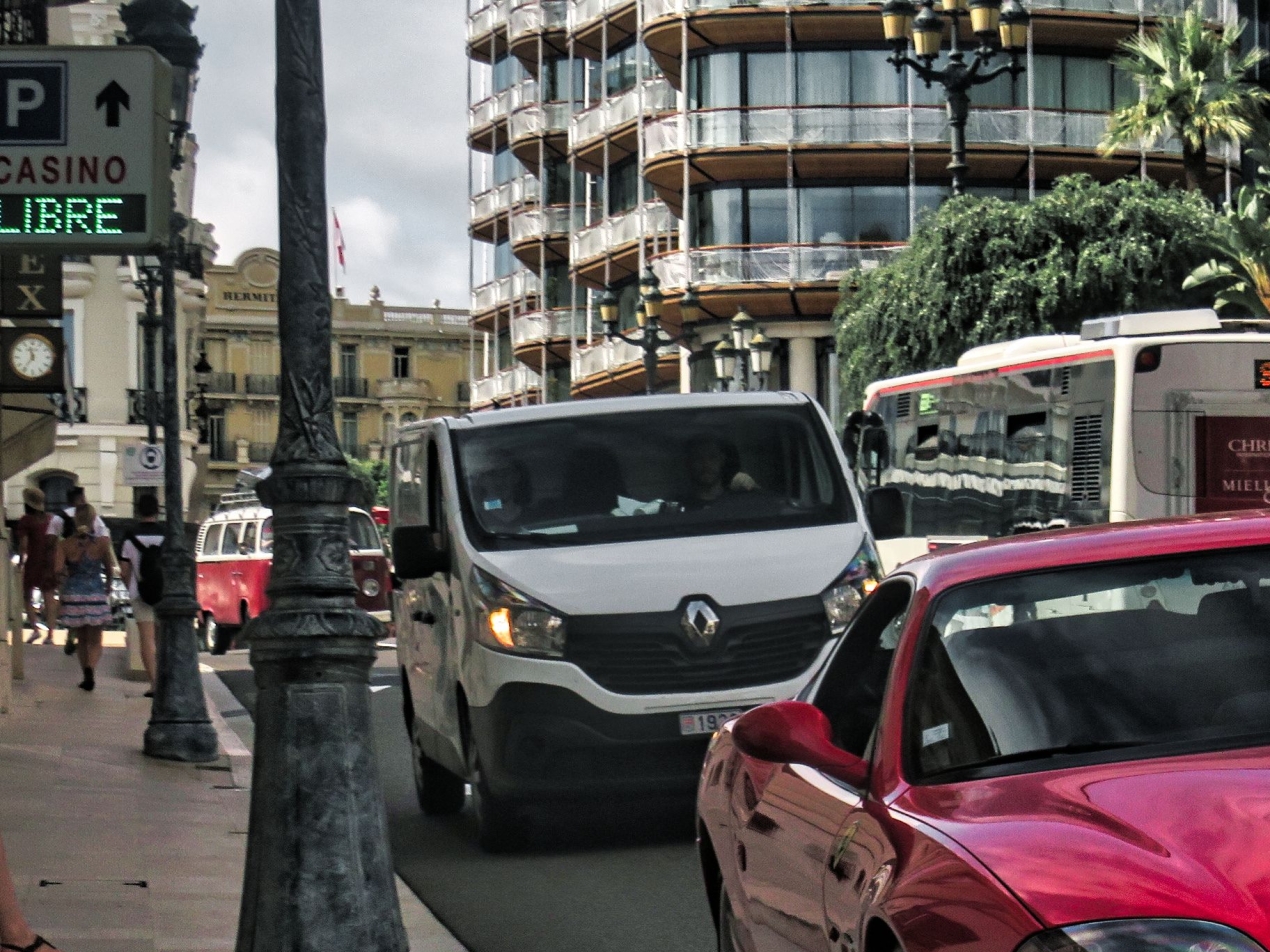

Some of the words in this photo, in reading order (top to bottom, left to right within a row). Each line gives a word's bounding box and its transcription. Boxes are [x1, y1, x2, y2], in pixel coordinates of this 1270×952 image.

[7, 79, 46, 127] P
[0, 156, 126, 184] CASINO
[0, 197, 123, 234] LIBRE
